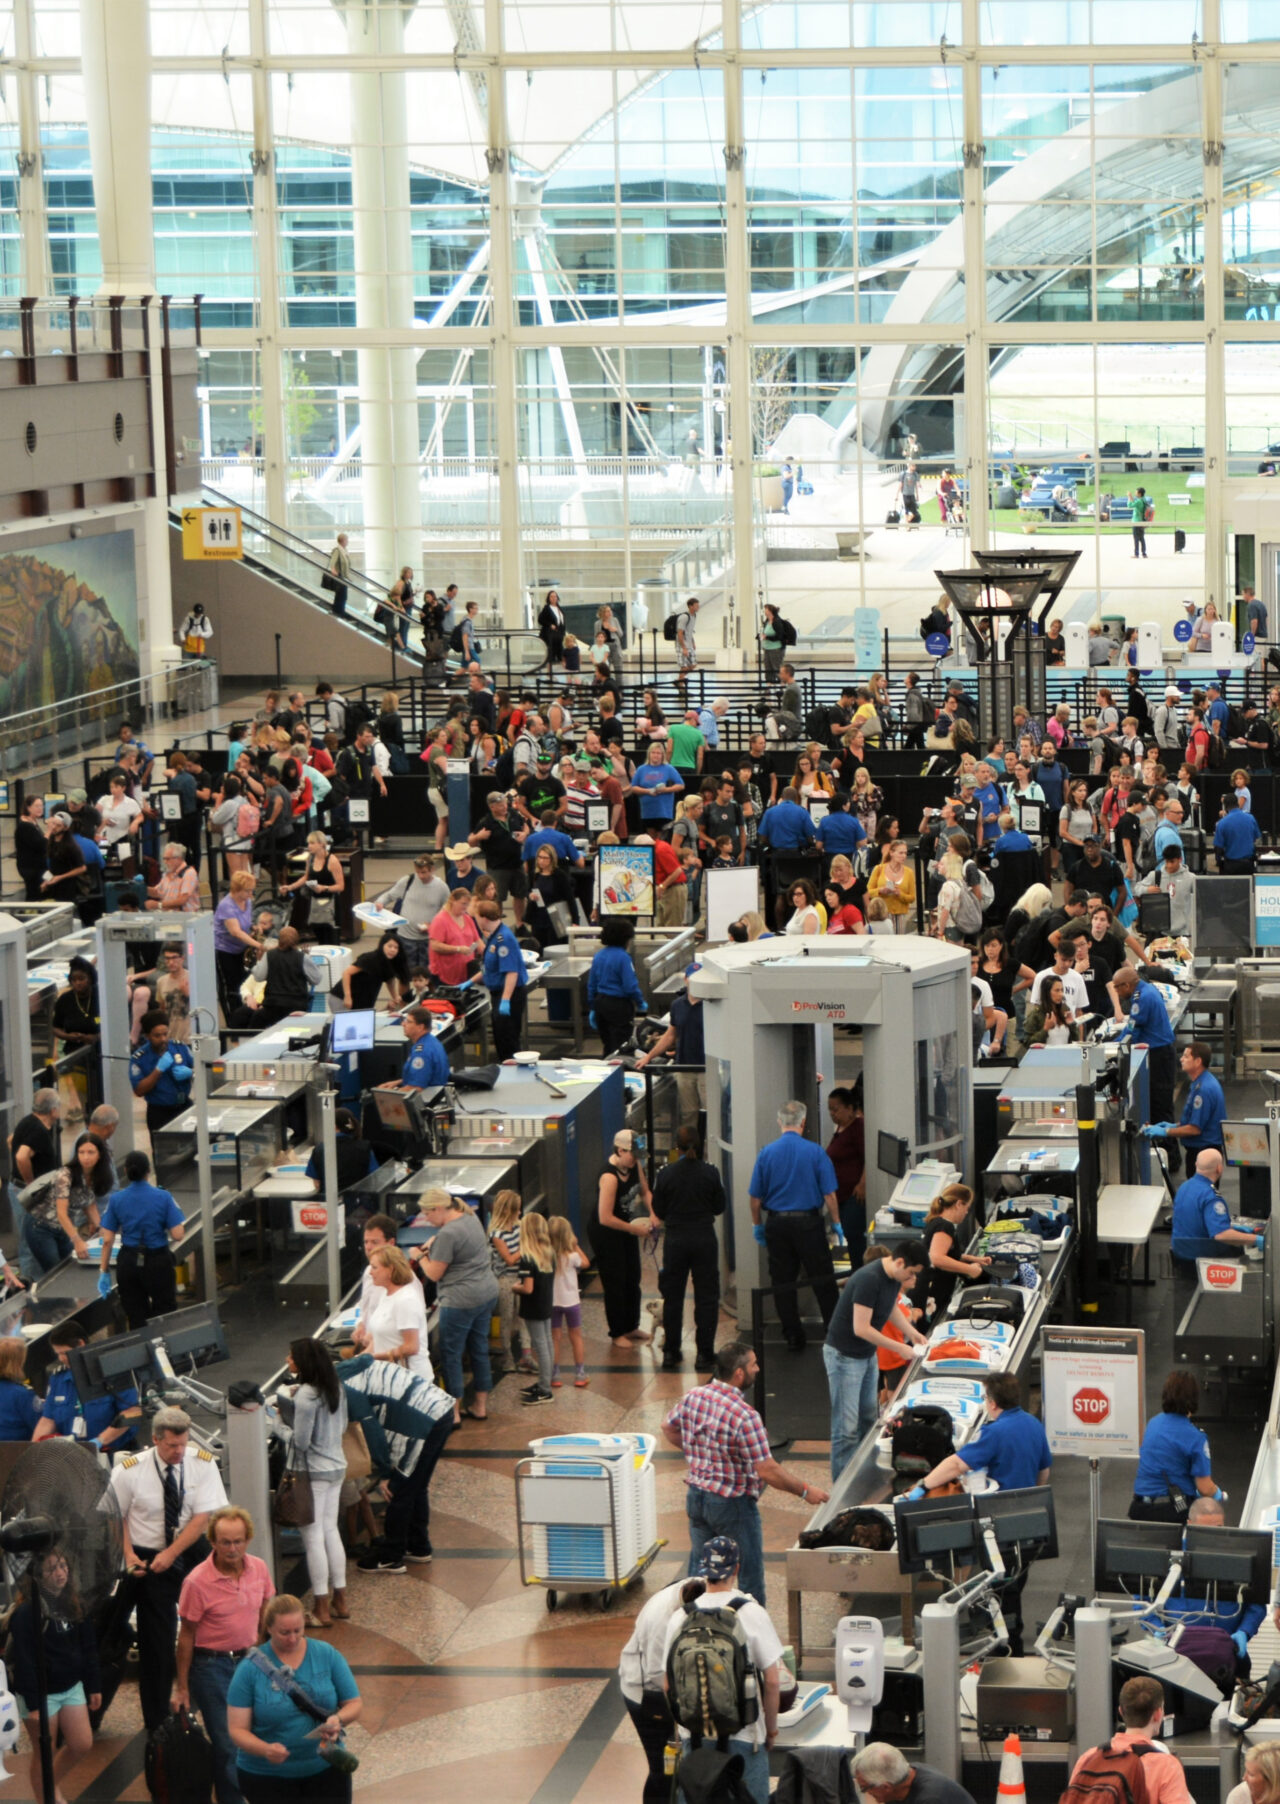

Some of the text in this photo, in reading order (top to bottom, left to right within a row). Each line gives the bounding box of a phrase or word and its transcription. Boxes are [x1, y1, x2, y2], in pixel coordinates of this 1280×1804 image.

[1082, 1048, 1087, 1059] 5
[1271, 1107, 1276, 1120] 6
[304, 1212, 326, 1221] STOP
[1210, 1270, 1234, 1279] STOP
[1074, 1399, 1107, 1412] STOP
